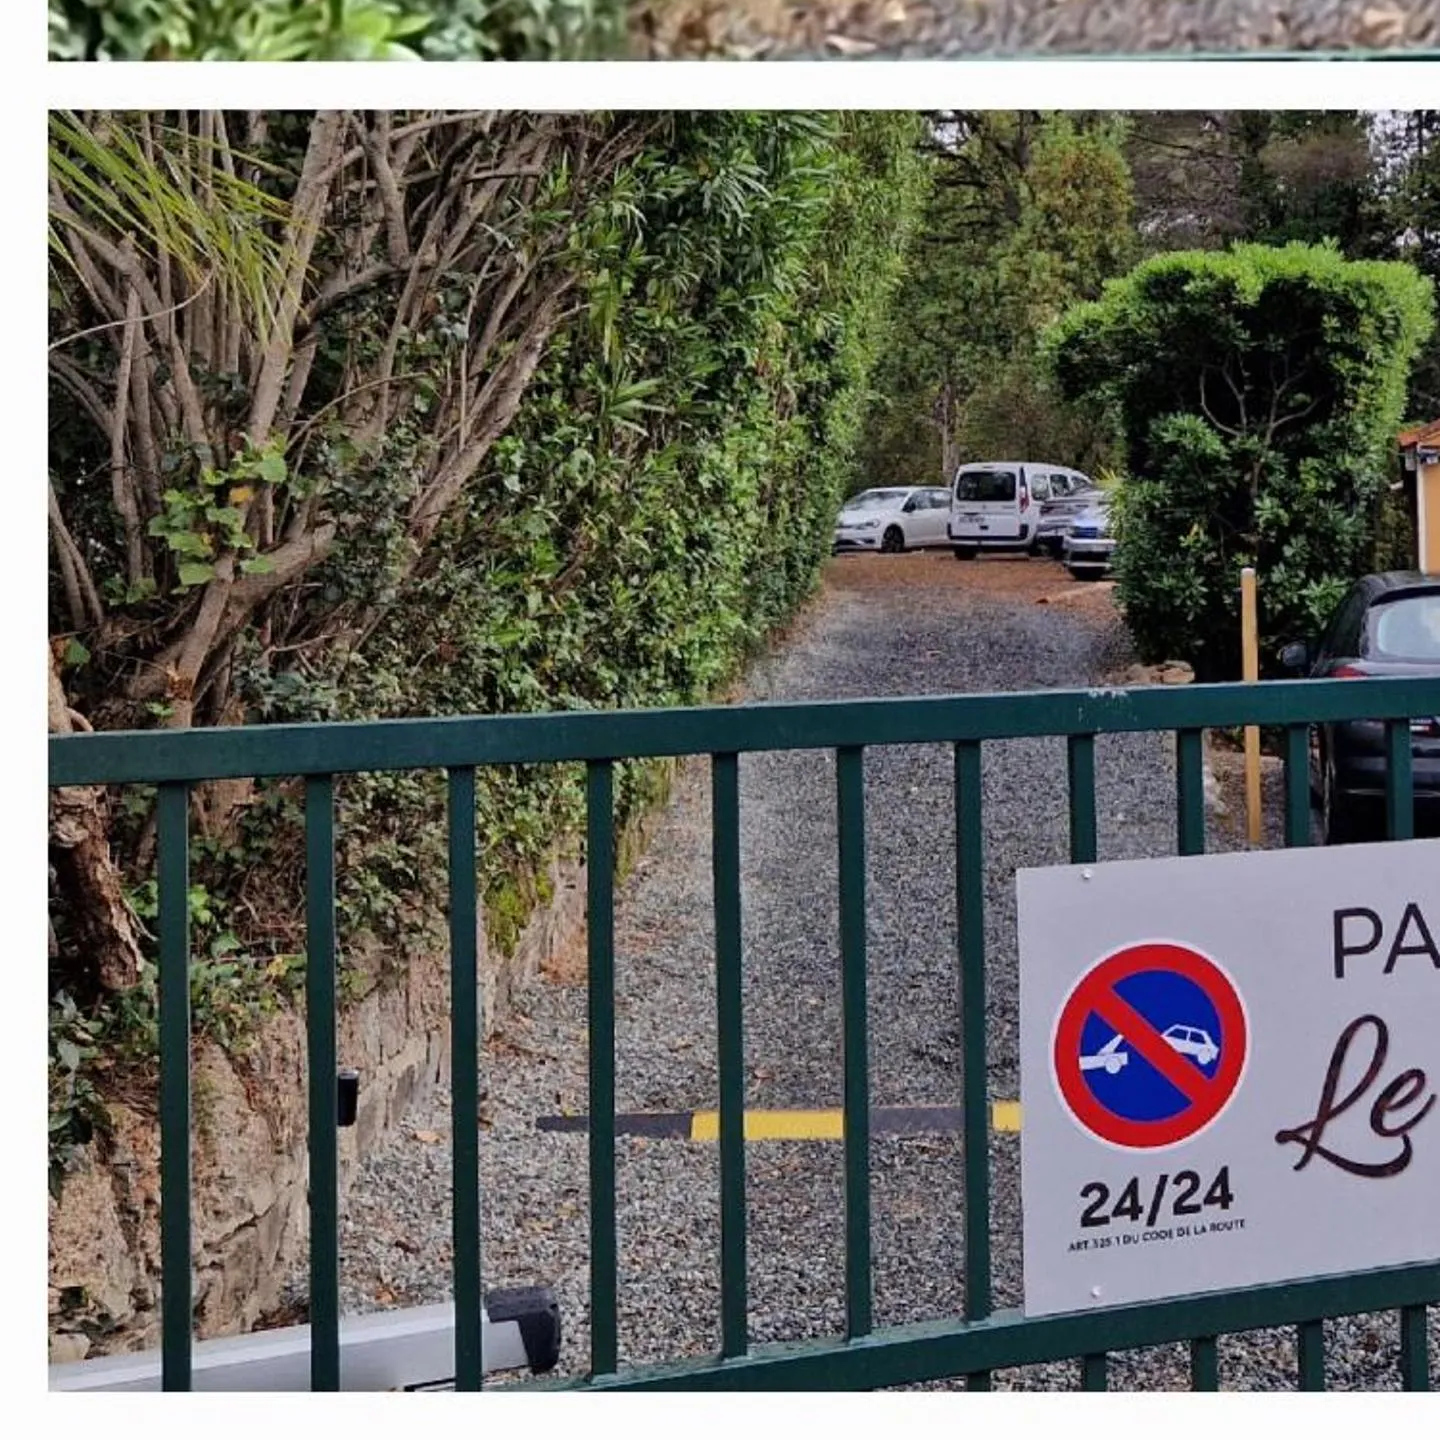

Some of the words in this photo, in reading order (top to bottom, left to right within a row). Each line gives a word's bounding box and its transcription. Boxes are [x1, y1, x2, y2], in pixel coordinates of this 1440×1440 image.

[1275, 1014, 1436, 1179] Le
[1080, 1165, 1235, 1228] 24/24
[1142, 1227, 1173, 1242] CODE
[1177, 1225, 1191, 1238] DE
[1194, 1223, 1207, 1236] LA
[1210, 1219, 1246, 1233] ROUTE
